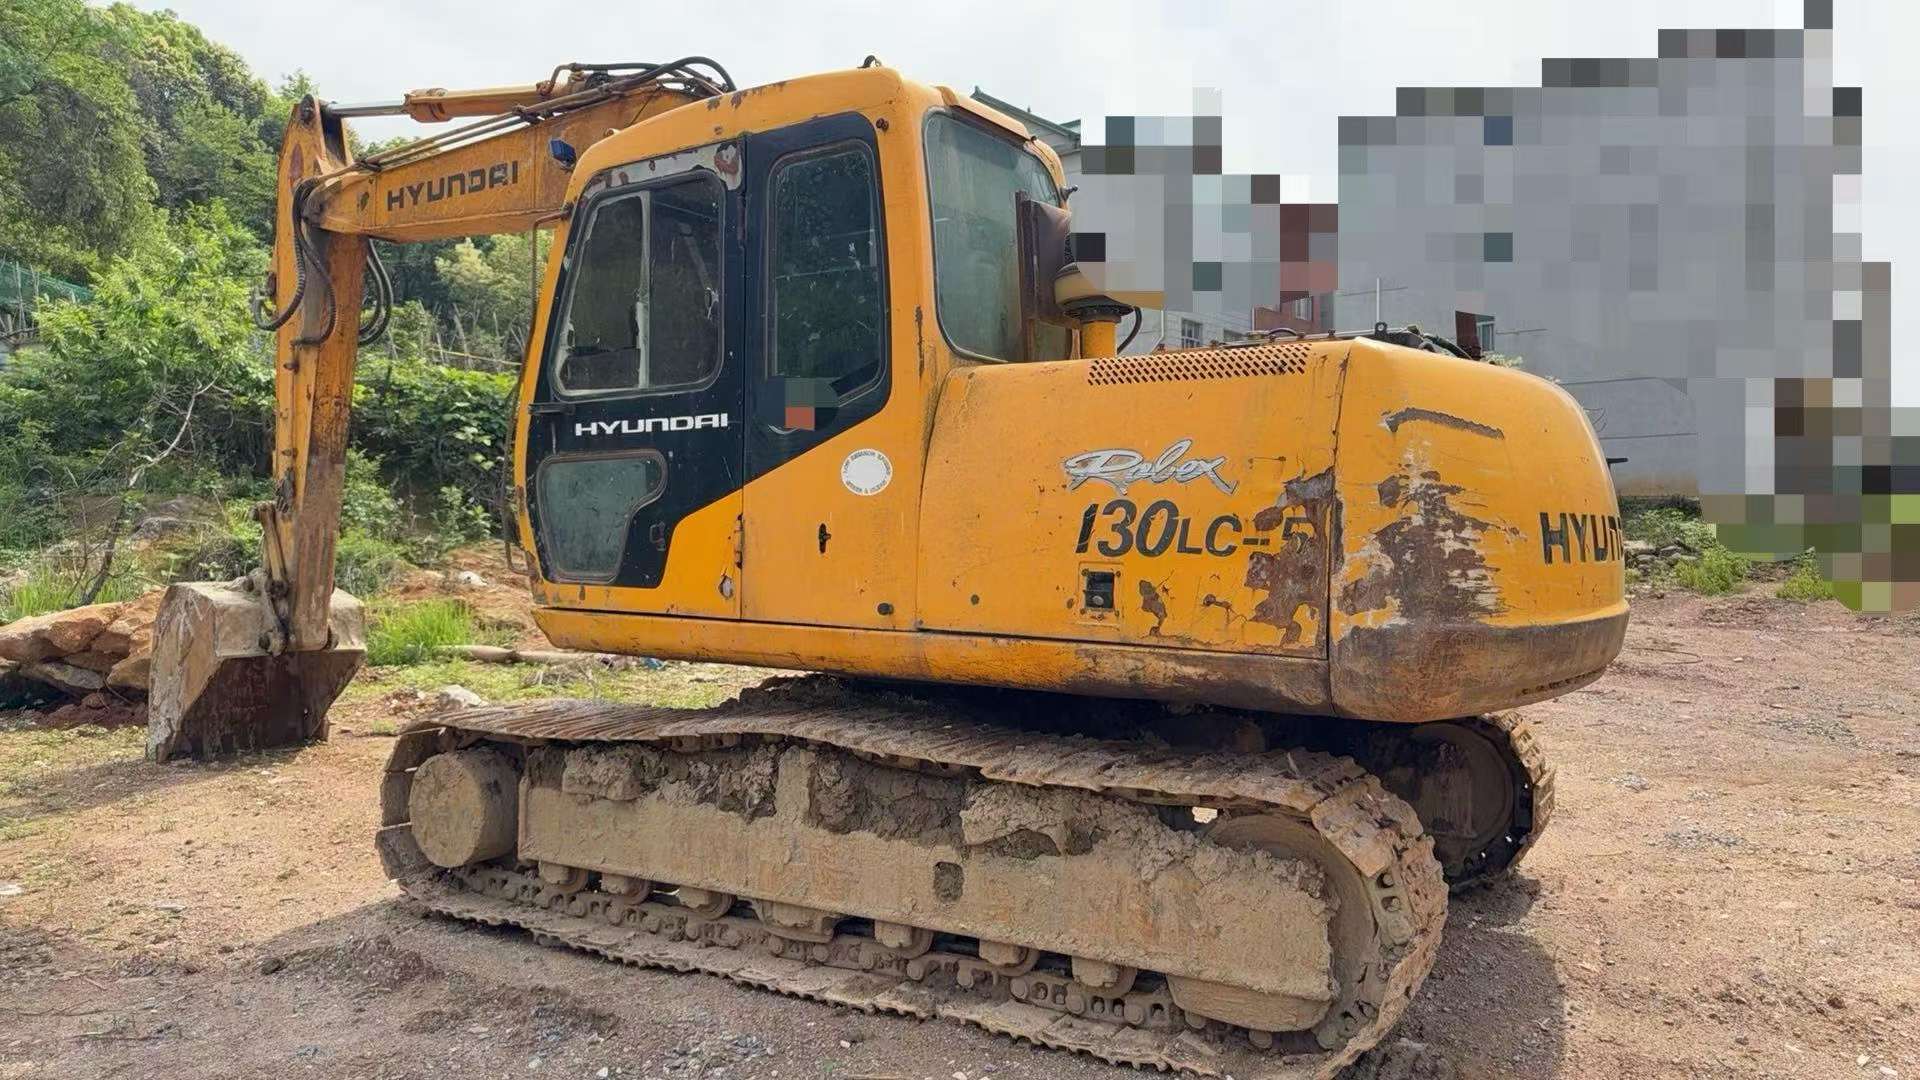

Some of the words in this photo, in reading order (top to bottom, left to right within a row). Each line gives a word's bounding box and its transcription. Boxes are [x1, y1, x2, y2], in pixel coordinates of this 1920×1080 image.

[387, 160, 518, 212] HYUNDAI
[575, 412, 728, 437] HYUNDAI
[1064, 439, 1240, 495] Robex
